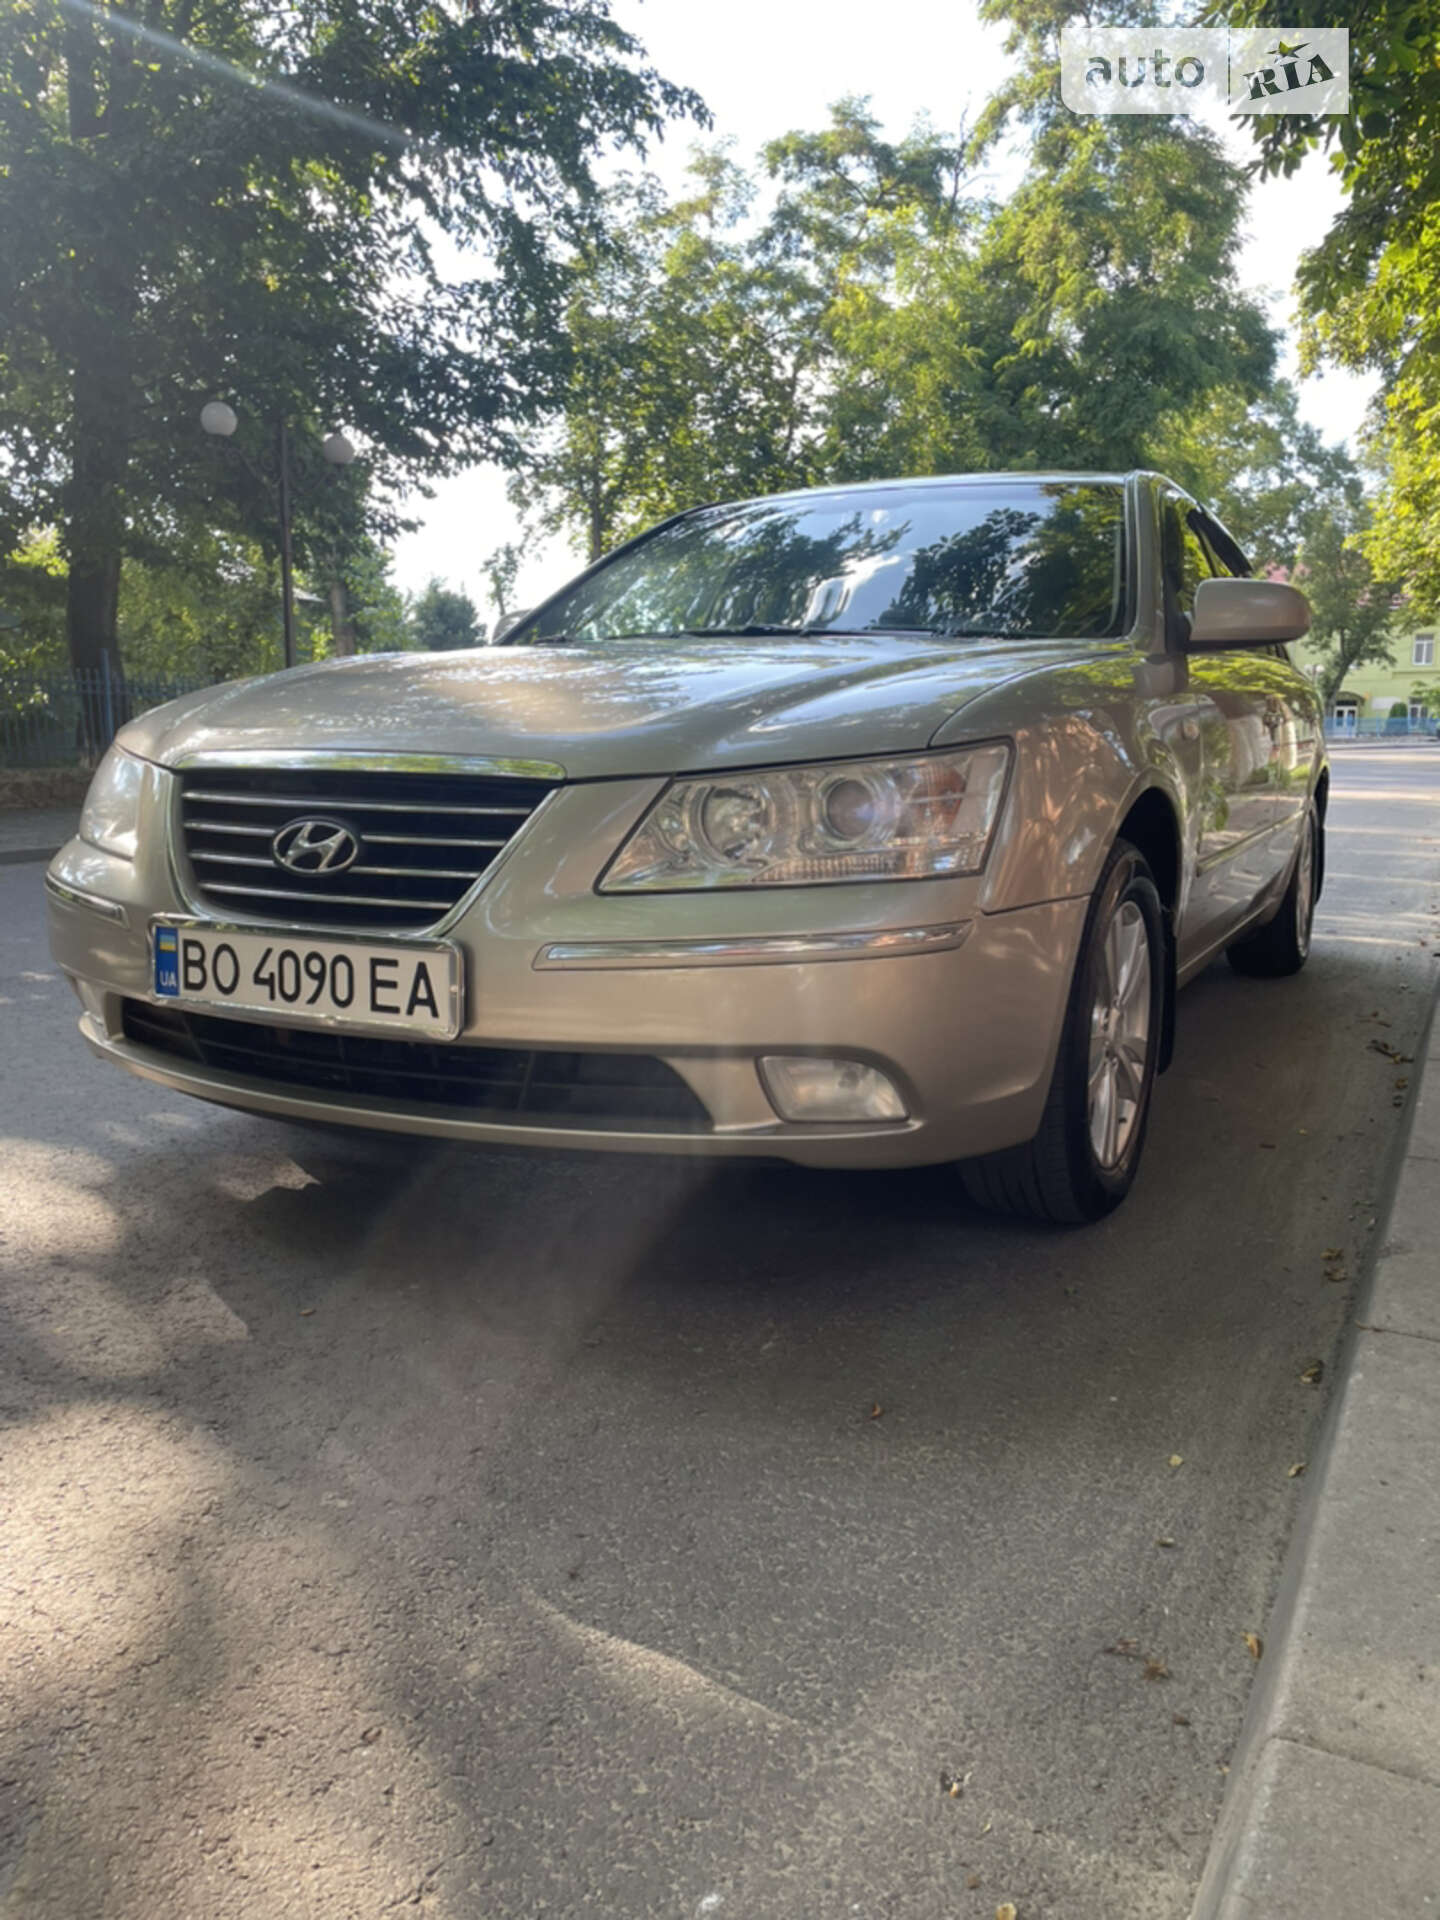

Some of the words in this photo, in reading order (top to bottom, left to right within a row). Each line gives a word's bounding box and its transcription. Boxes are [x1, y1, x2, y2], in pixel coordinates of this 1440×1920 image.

[159, 970, 177, 988] UA
[182, 939, 240, 995] BO
[252, 947, 355, 1008] 4090
[369, 957, 439, 1018] EA
